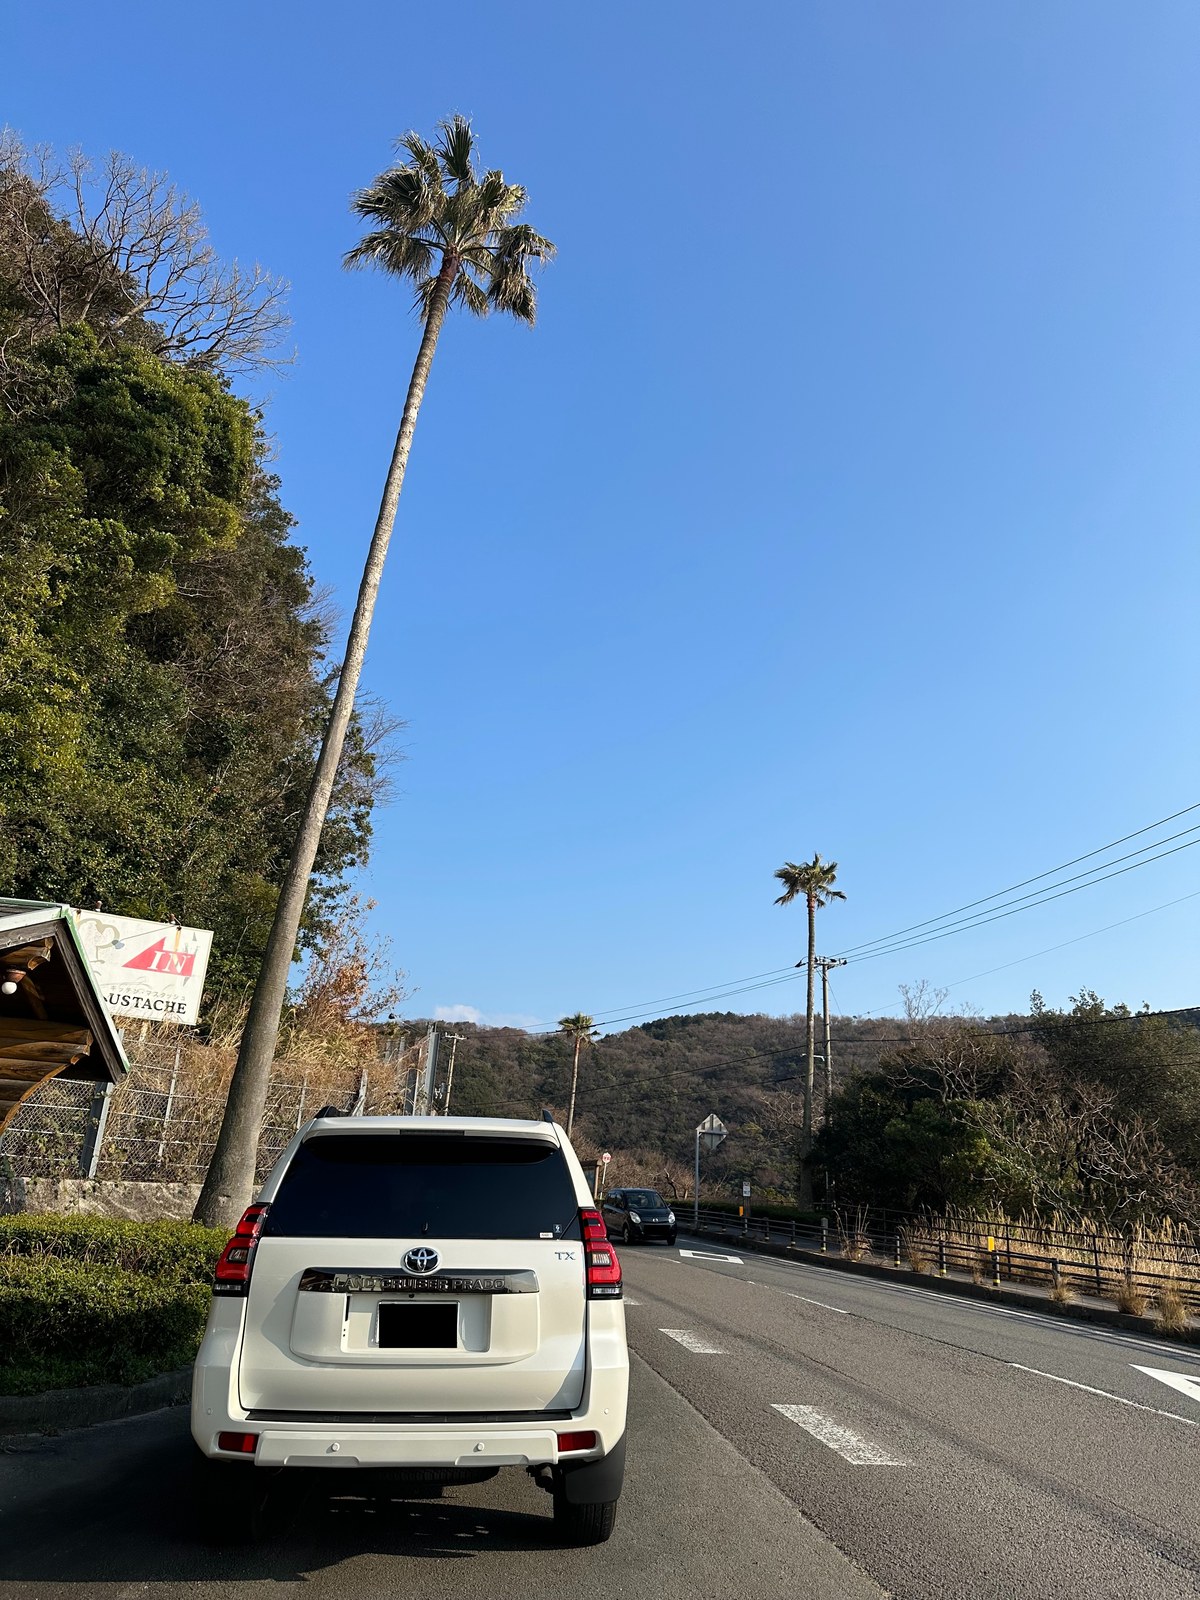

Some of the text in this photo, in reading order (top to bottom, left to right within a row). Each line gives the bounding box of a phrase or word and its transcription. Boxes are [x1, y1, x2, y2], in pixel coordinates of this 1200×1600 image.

[147, 950, 192, 973] IN
[103, 992, 187, 1015] USTACHE
[554, 1251, 576, 1261] TX
[334, 1274, 505, 1290] LAND CRUISER PRADO
